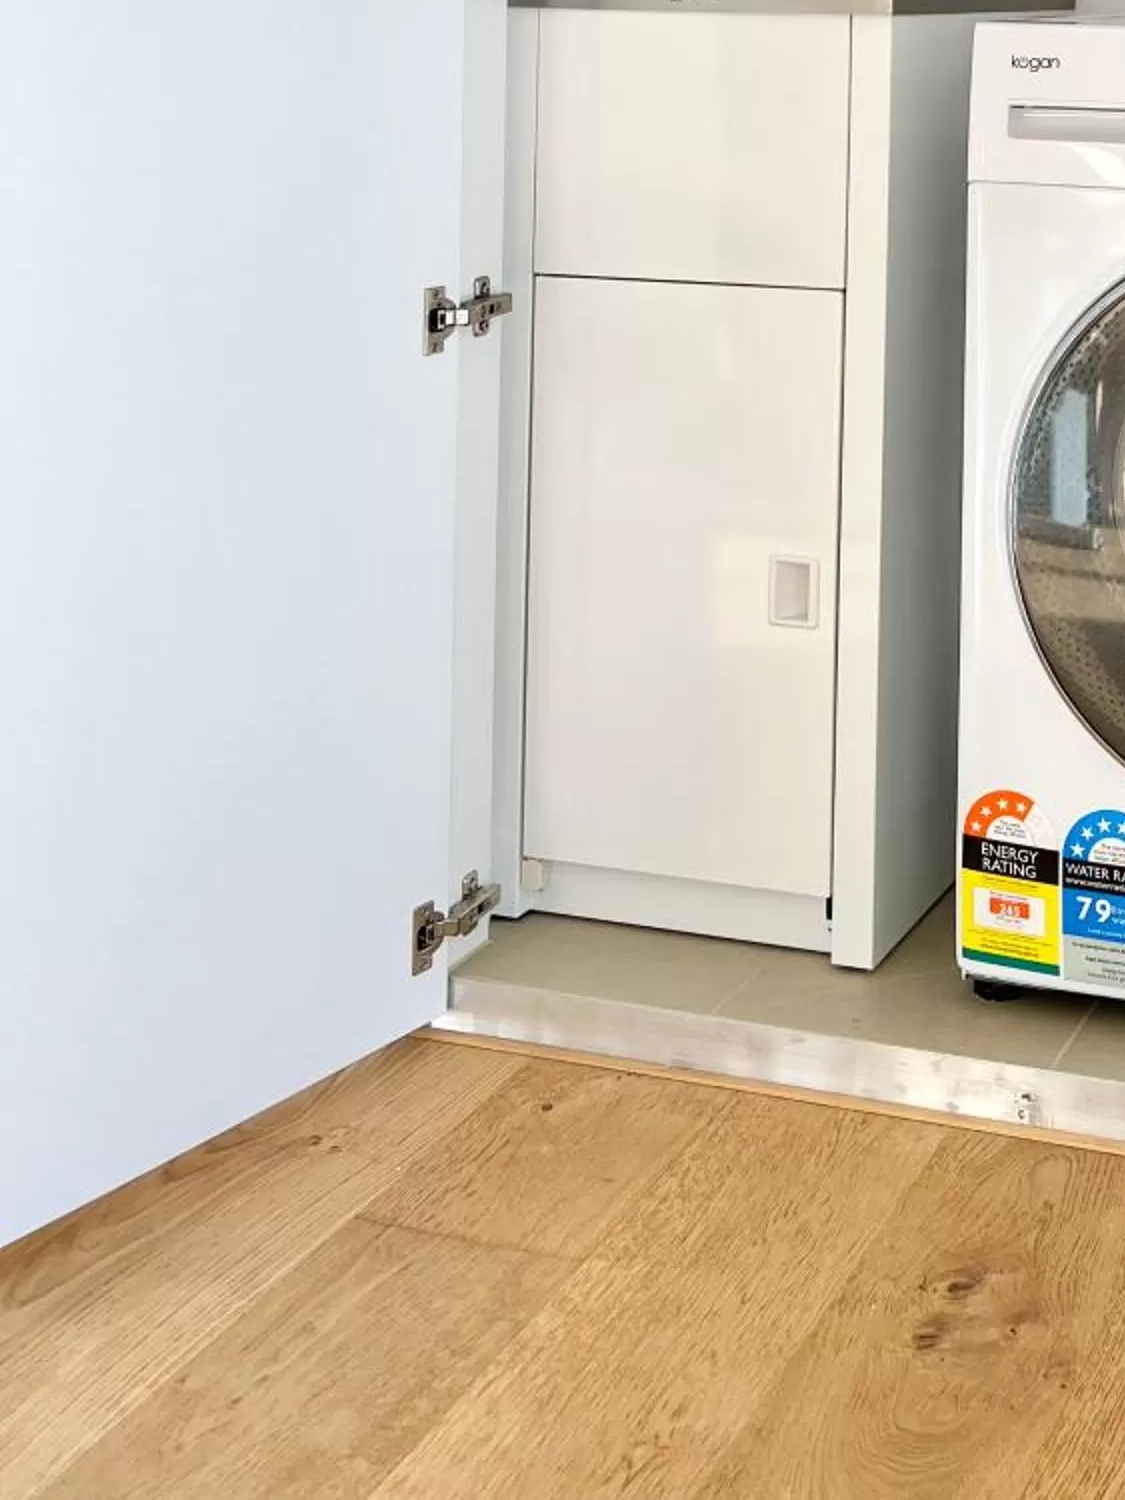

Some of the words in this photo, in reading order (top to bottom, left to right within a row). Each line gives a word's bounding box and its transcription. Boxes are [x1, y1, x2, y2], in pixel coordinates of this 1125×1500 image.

[981, 842, 1039, 864] ENERGY
[982, 858, 1037, 879] RATING
[1065, 862, 1110, 880] WATER
[1076, 896, 1111, 923] 79
